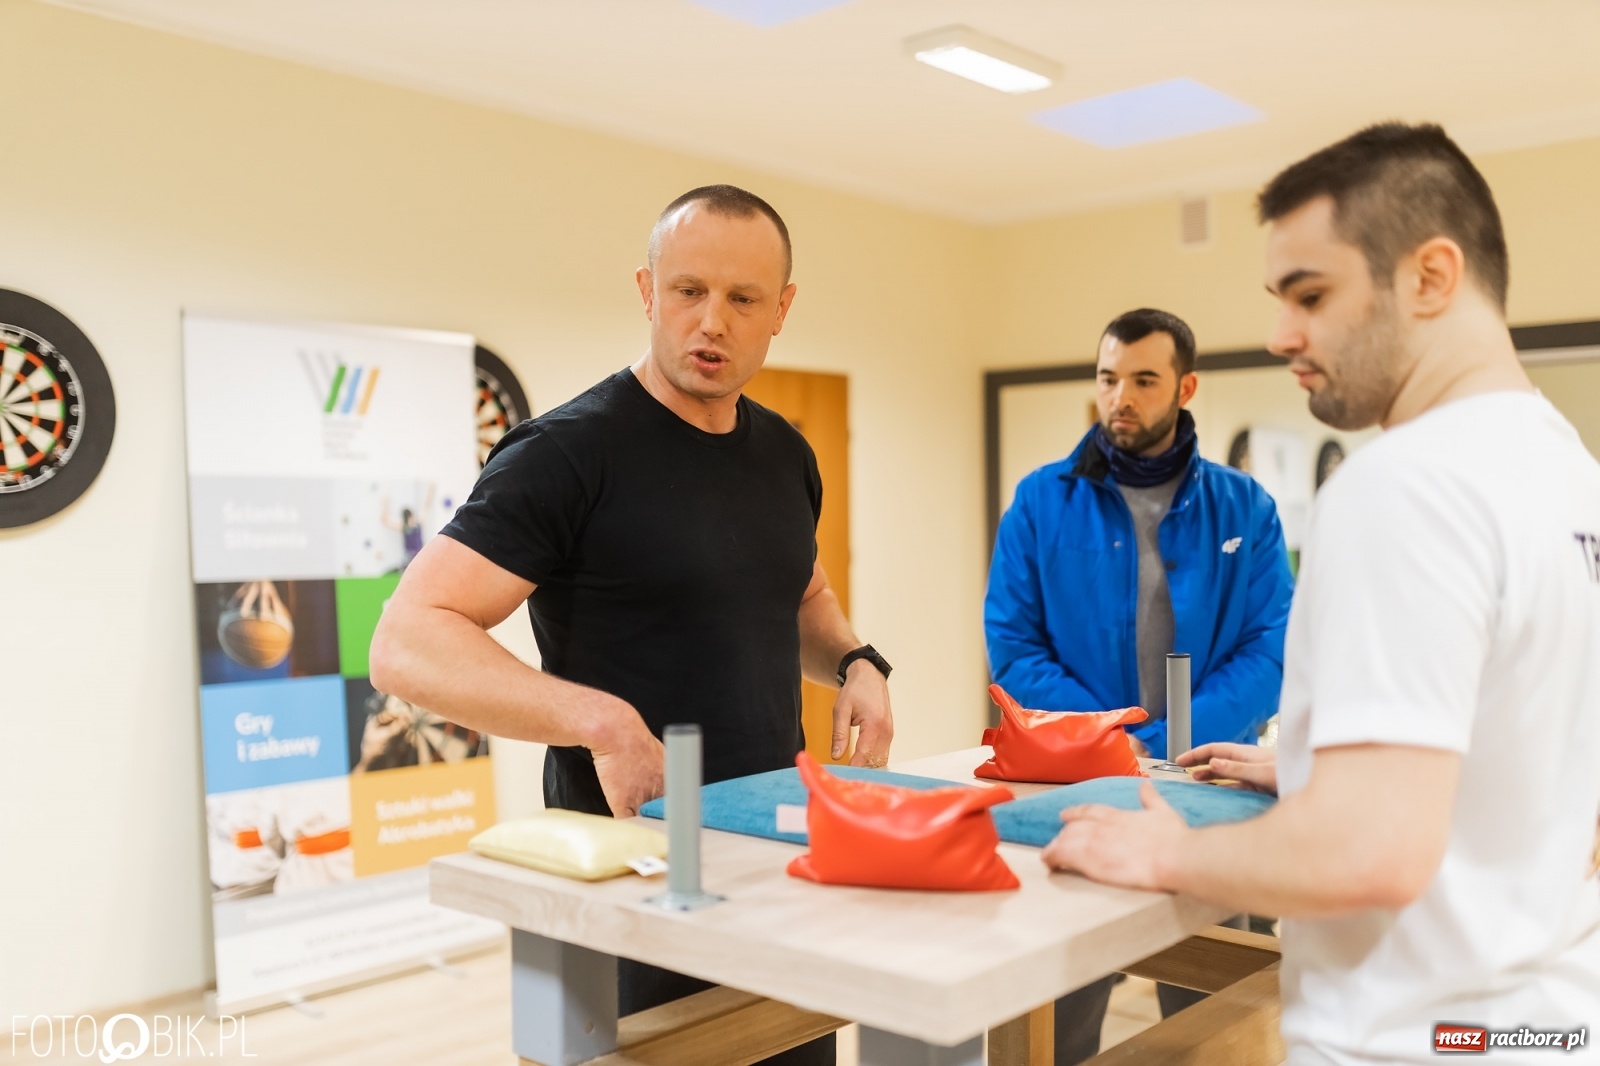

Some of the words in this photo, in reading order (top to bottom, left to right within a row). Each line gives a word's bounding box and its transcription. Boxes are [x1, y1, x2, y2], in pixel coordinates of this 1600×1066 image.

[234, 711, 274, 737] Gry
[237, 739, 246, 762] i
[248, 735, 320, 761] zabawy
[375, 797, 428, 821] Sztuki
[430, 788, 475, 811] walki
[377, 815, 475, 845] Akrobatyka
